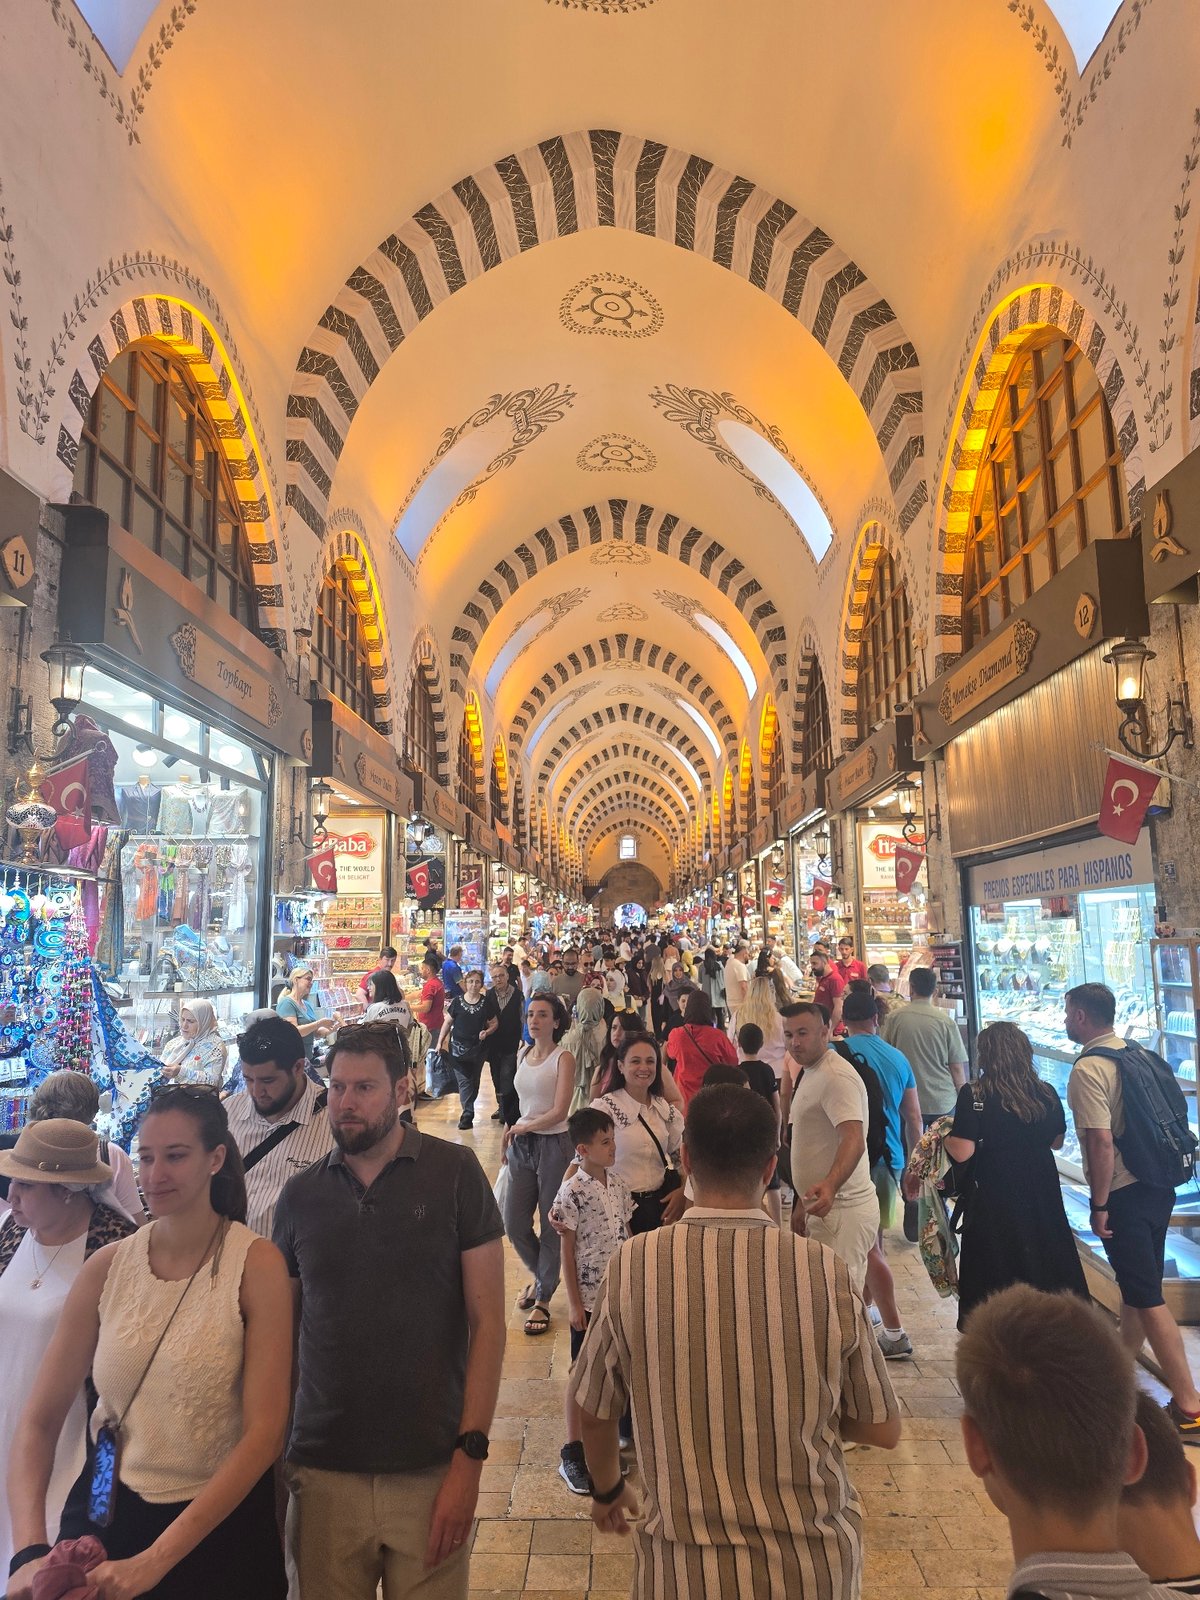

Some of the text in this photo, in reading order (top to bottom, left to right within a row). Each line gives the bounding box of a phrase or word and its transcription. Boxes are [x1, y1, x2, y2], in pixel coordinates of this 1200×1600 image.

[13, 550, 25, 577] 11
[1079, 604, 1090, 628] 12
[979, 640, 1014, 688] Diamond
[312, 837, 367, 852] erBaba
[983, 853, 1133, 900] PRECIOS ESPECIALES PARA HISPANOS
